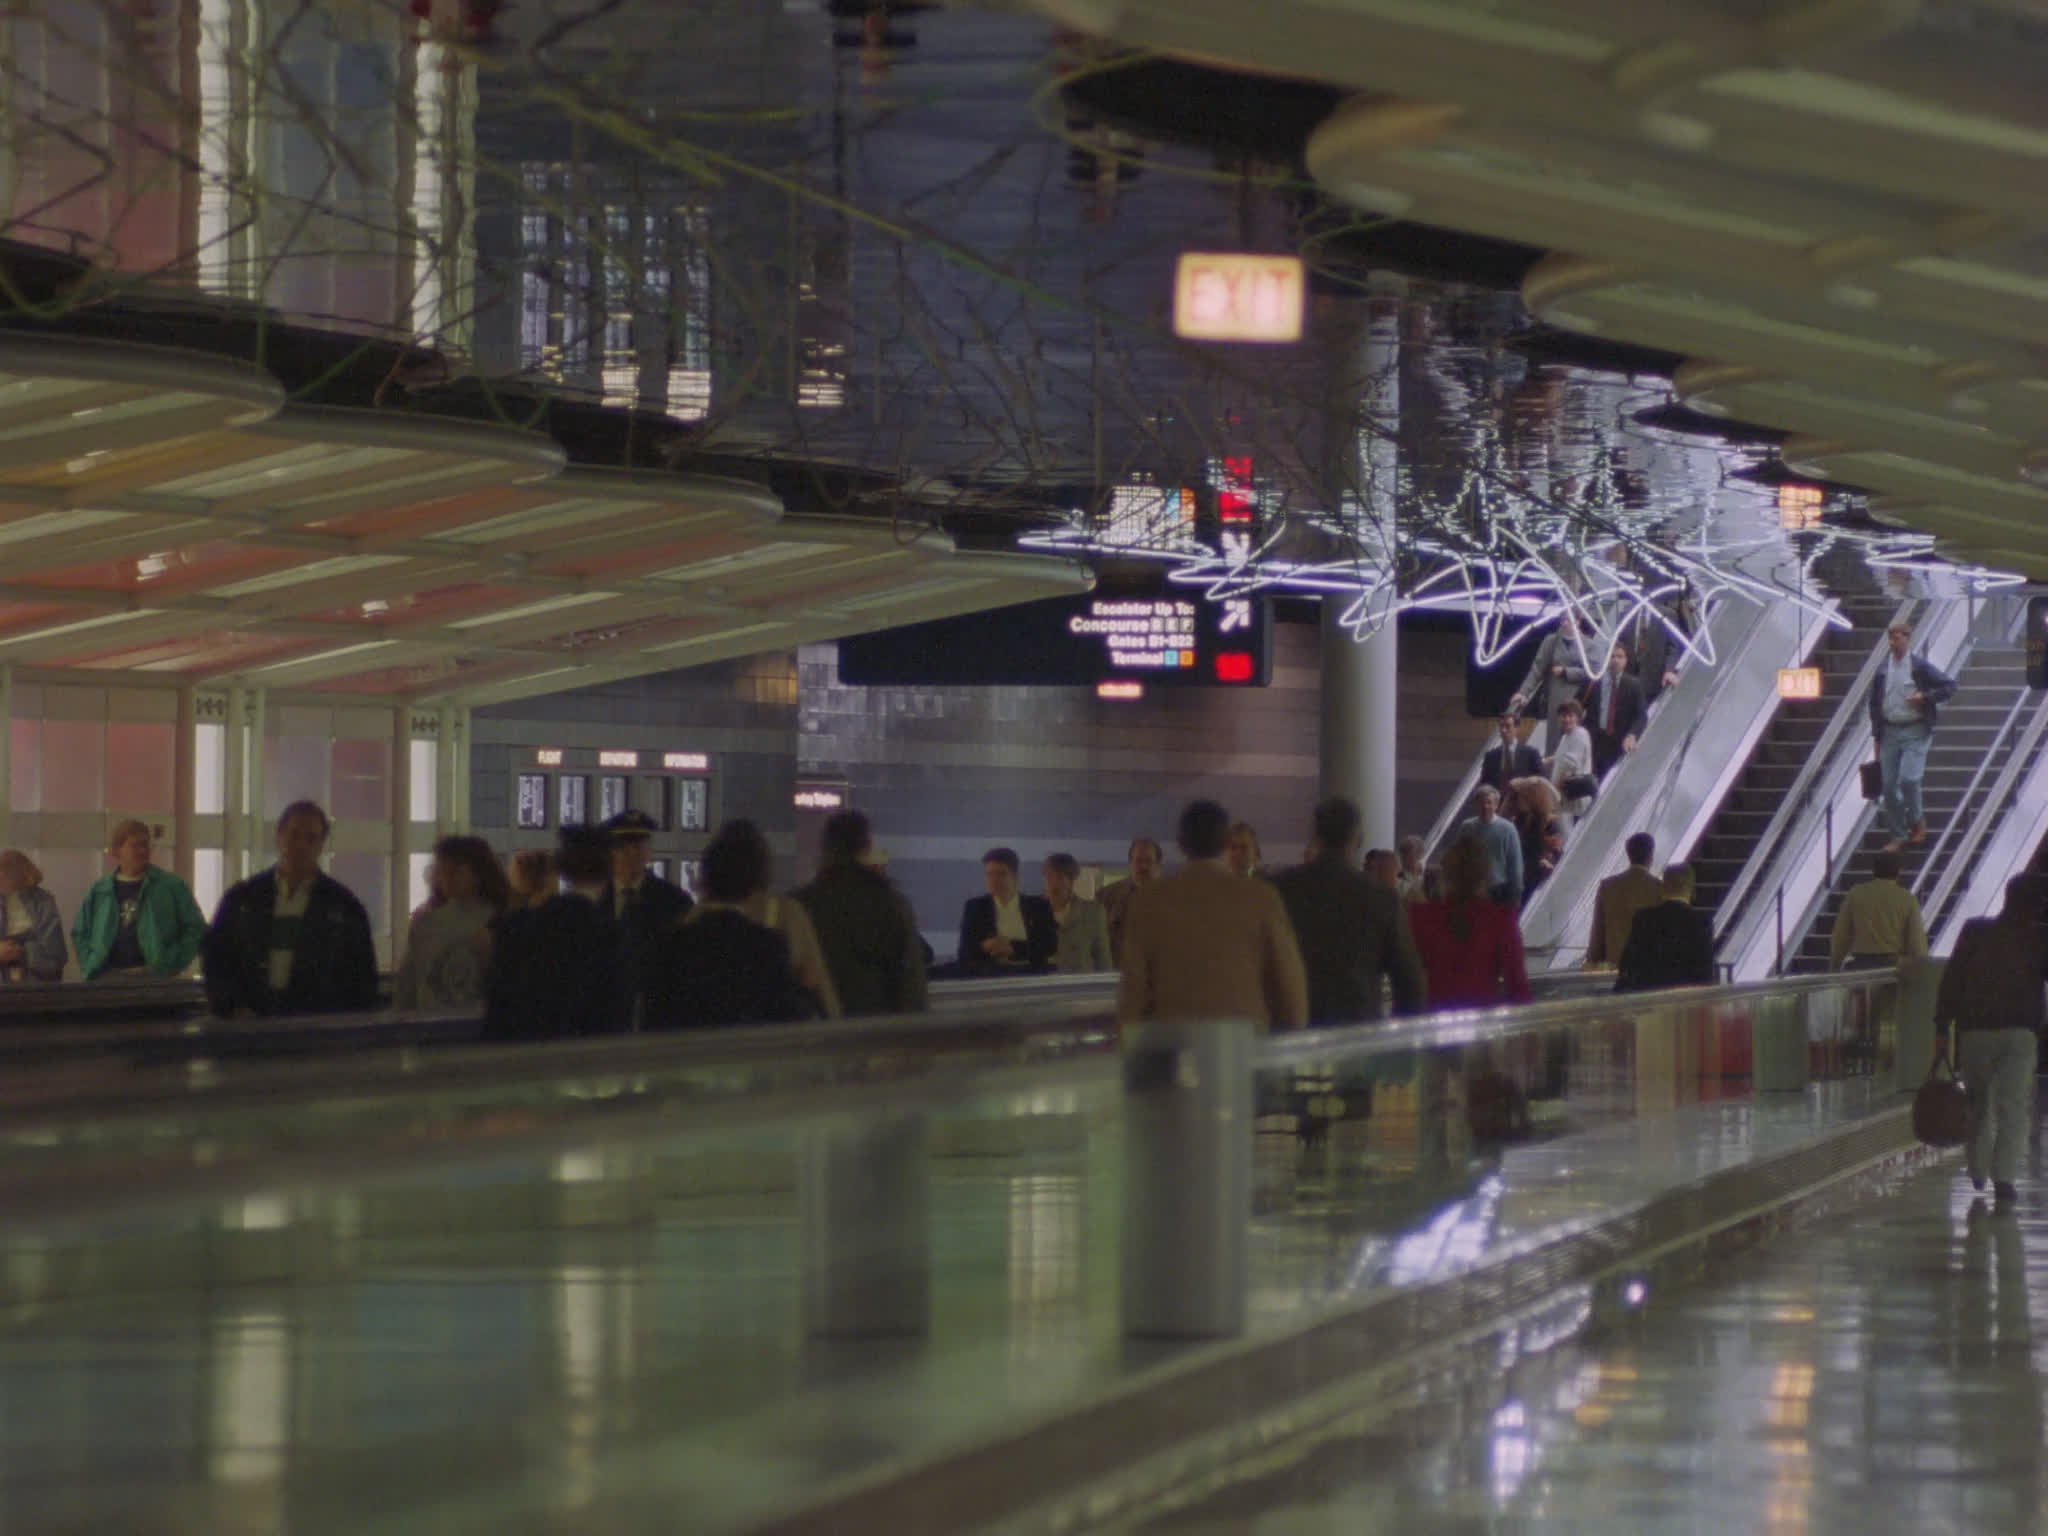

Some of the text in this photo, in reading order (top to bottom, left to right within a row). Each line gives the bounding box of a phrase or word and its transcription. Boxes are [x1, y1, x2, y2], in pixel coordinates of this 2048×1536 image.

[1191, 267, 1289, 322] EXIT
[1093, 602, 1152, 615] Escalator
[1155, 602, 1173, 616] Up
[1070, 617, 1149, 632] Concourse
[1108, 634, 1146, 647] Gates
[1112, 650, 1163, 665] Terminal
[1780, 671, 1816, 693] EXIT
